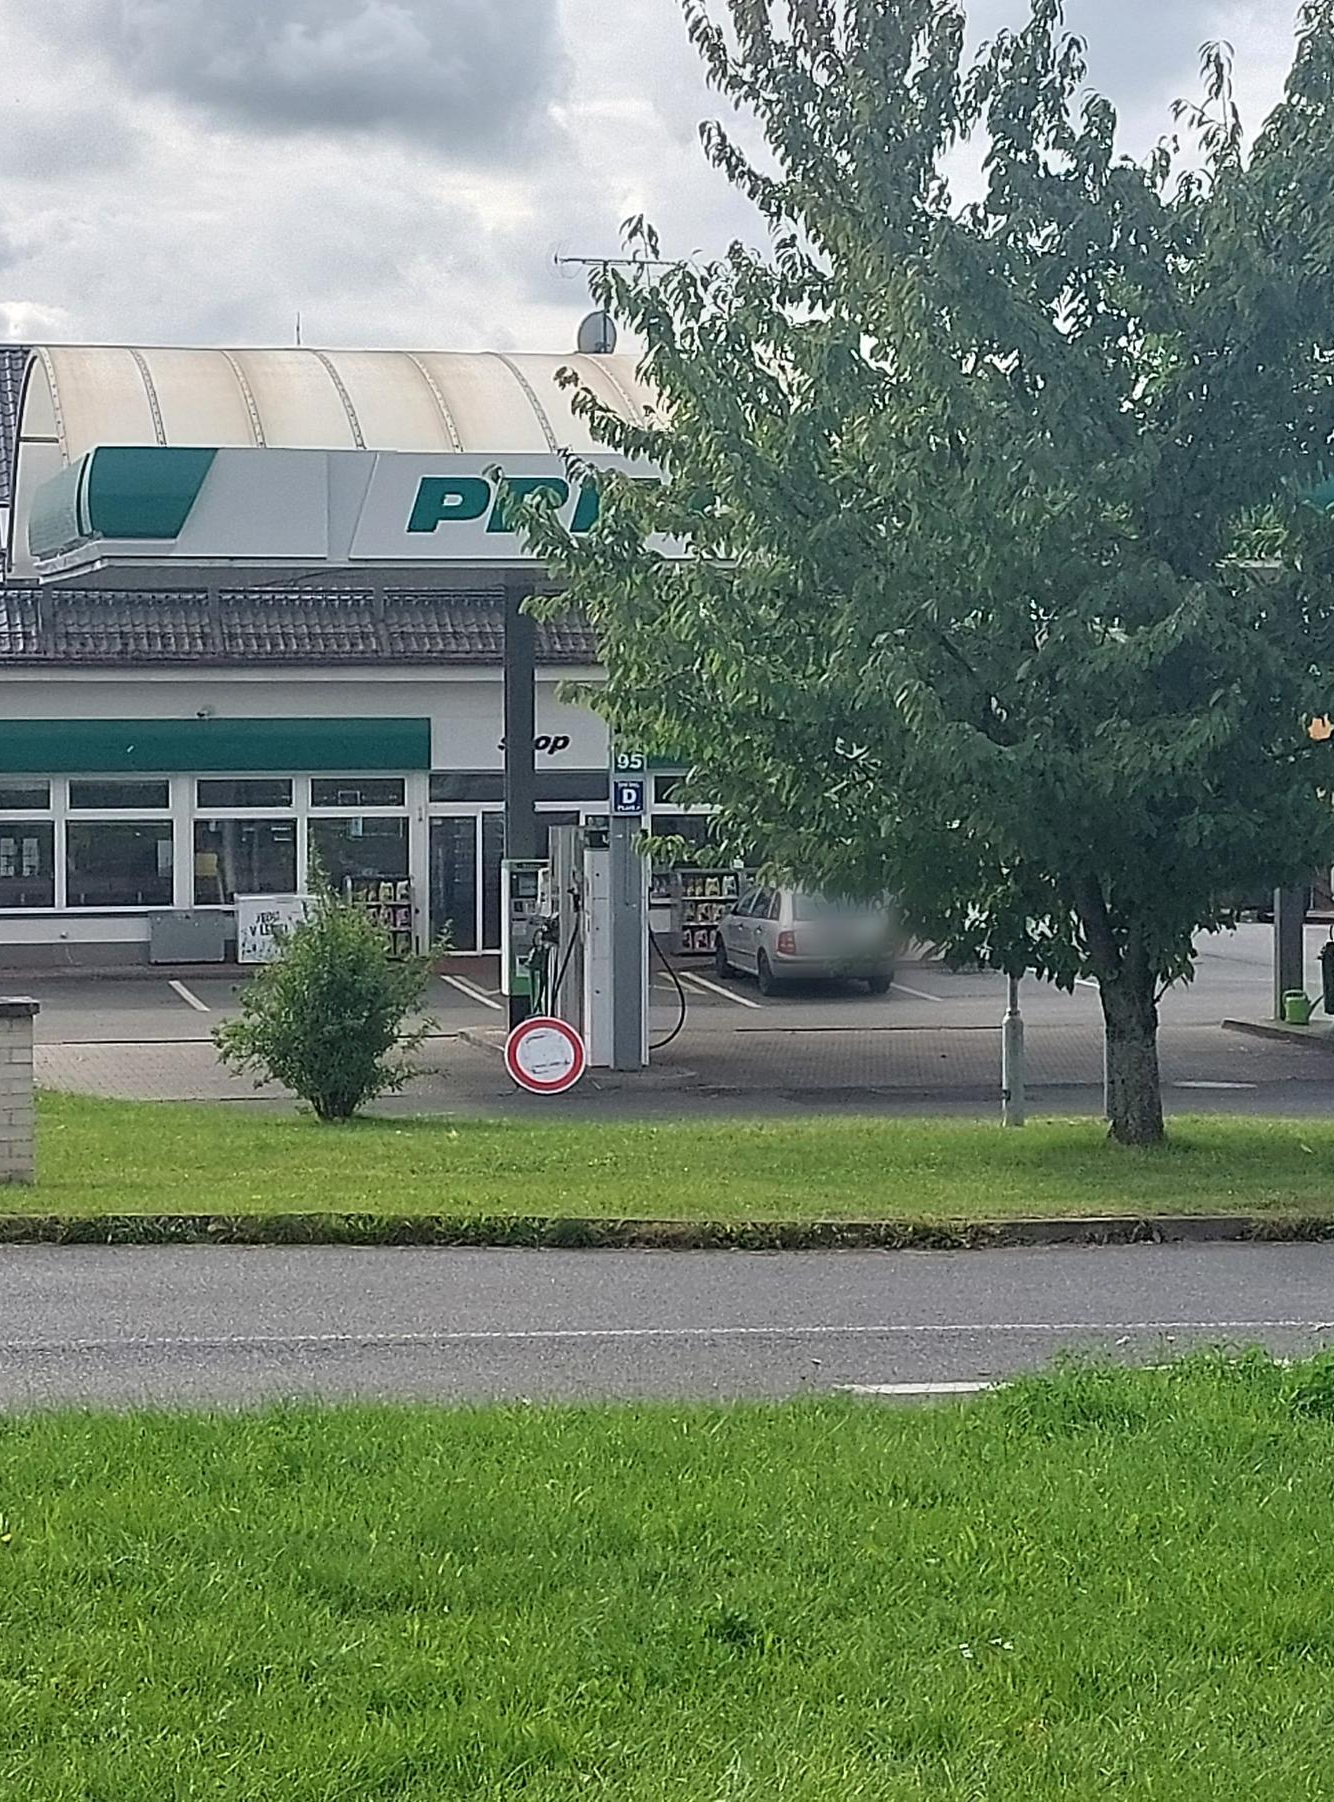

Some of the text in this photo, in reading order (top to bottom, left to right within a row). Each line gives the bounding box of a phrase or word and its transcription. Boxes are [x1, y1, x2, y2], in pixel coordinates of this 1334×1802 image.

[405, 476, 673, 534] PRI
[497, 735, 571, 755] sop
[617, 753, 643, 769] 95
[622, 788, 637, 804] D
